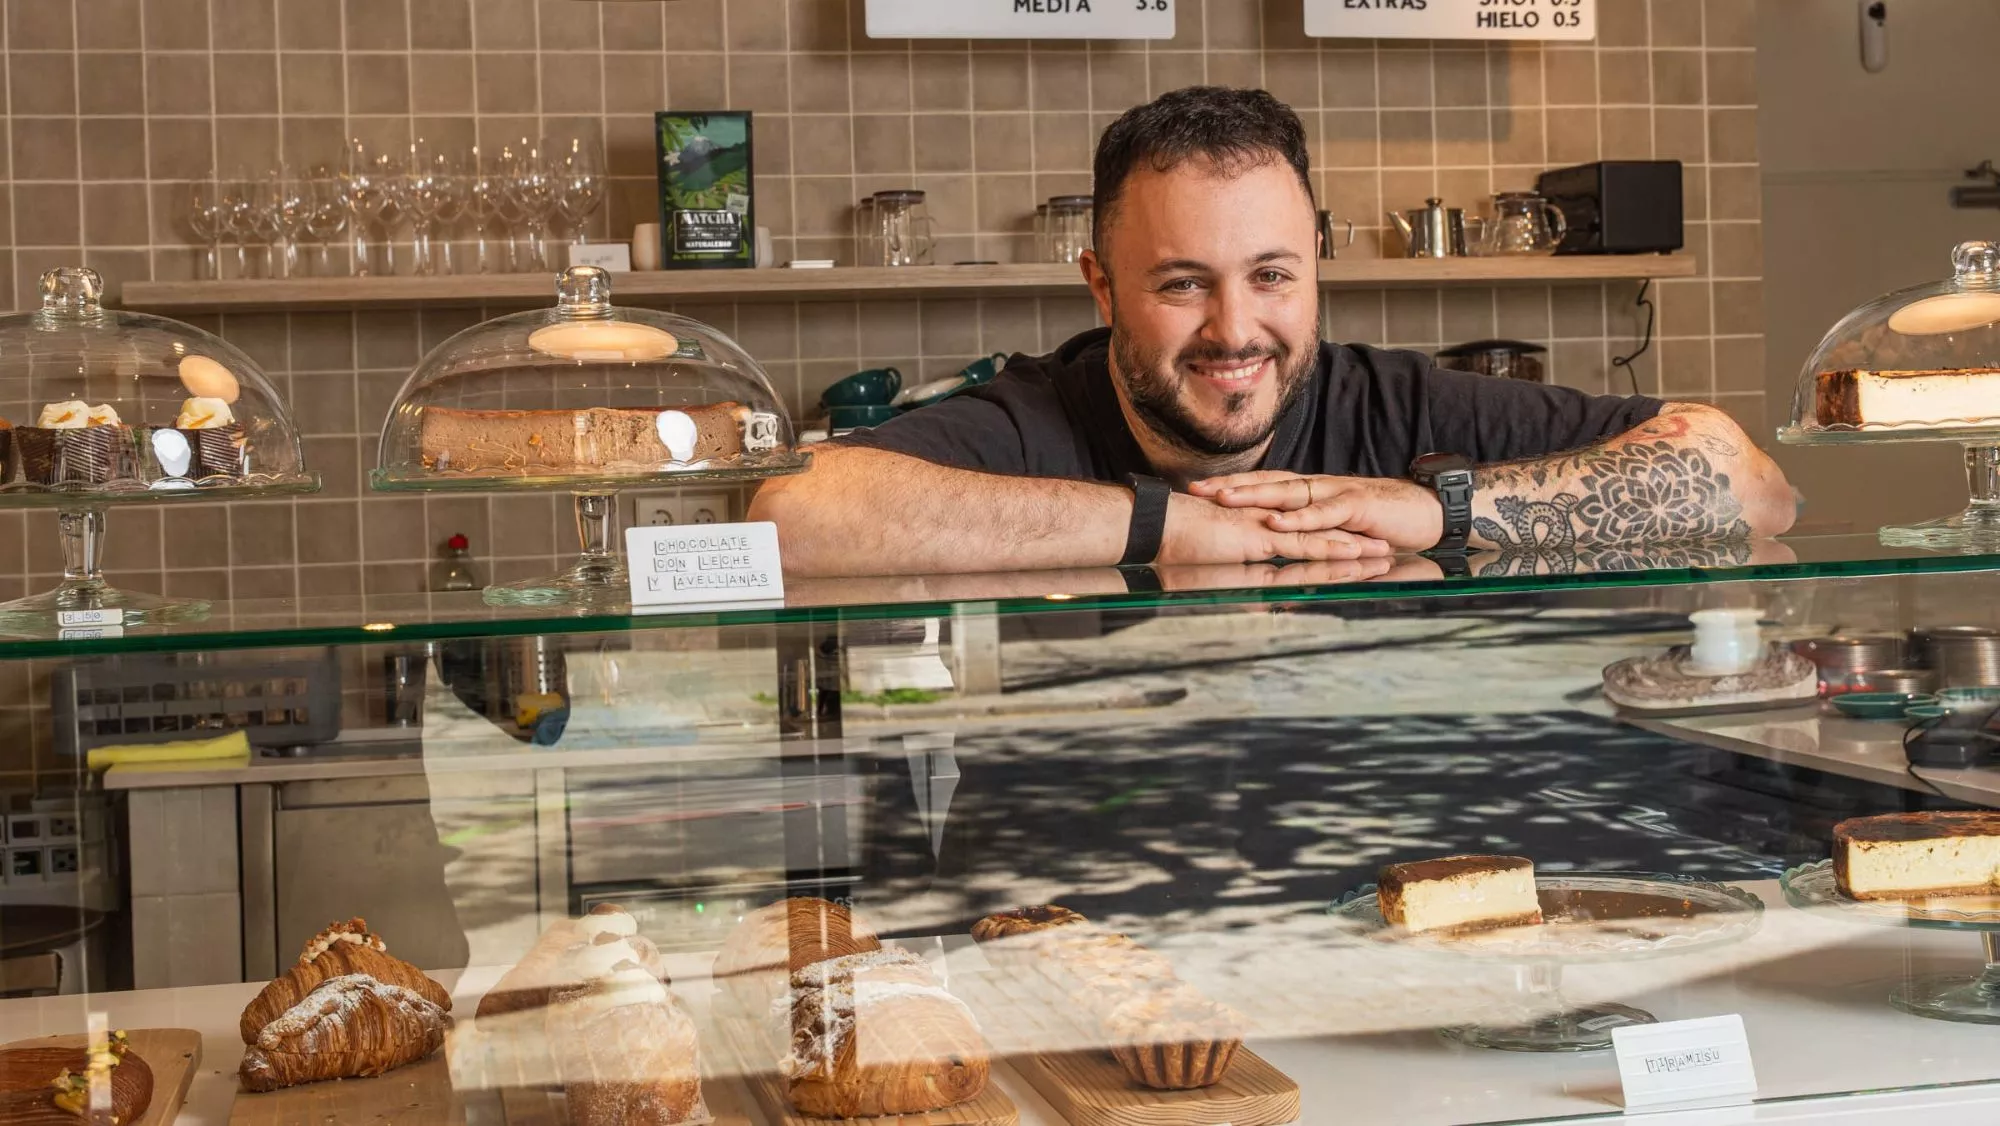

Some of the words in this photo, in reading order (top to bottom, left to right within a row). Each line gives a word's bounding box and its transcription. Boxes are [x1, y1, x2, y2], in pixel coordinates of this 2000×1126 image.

[1013, 0, 1091, 13] MEDIA
[1476, 11, 1540, 28] HIELO
[1553, 11, 1580, 27] 0.5
[680, 212, 735, 225] MATCHA
[657, 536, 748, 552] CHOCOLATE
[656, 559, 686, 569] CON
[701, 555, 750, 566] LECHE
[650, 577, 659, 586] Y
[677, 573, 768, 586] AVELLANAS
[1649, 1050, 1720, 1069] TIRAMISU
